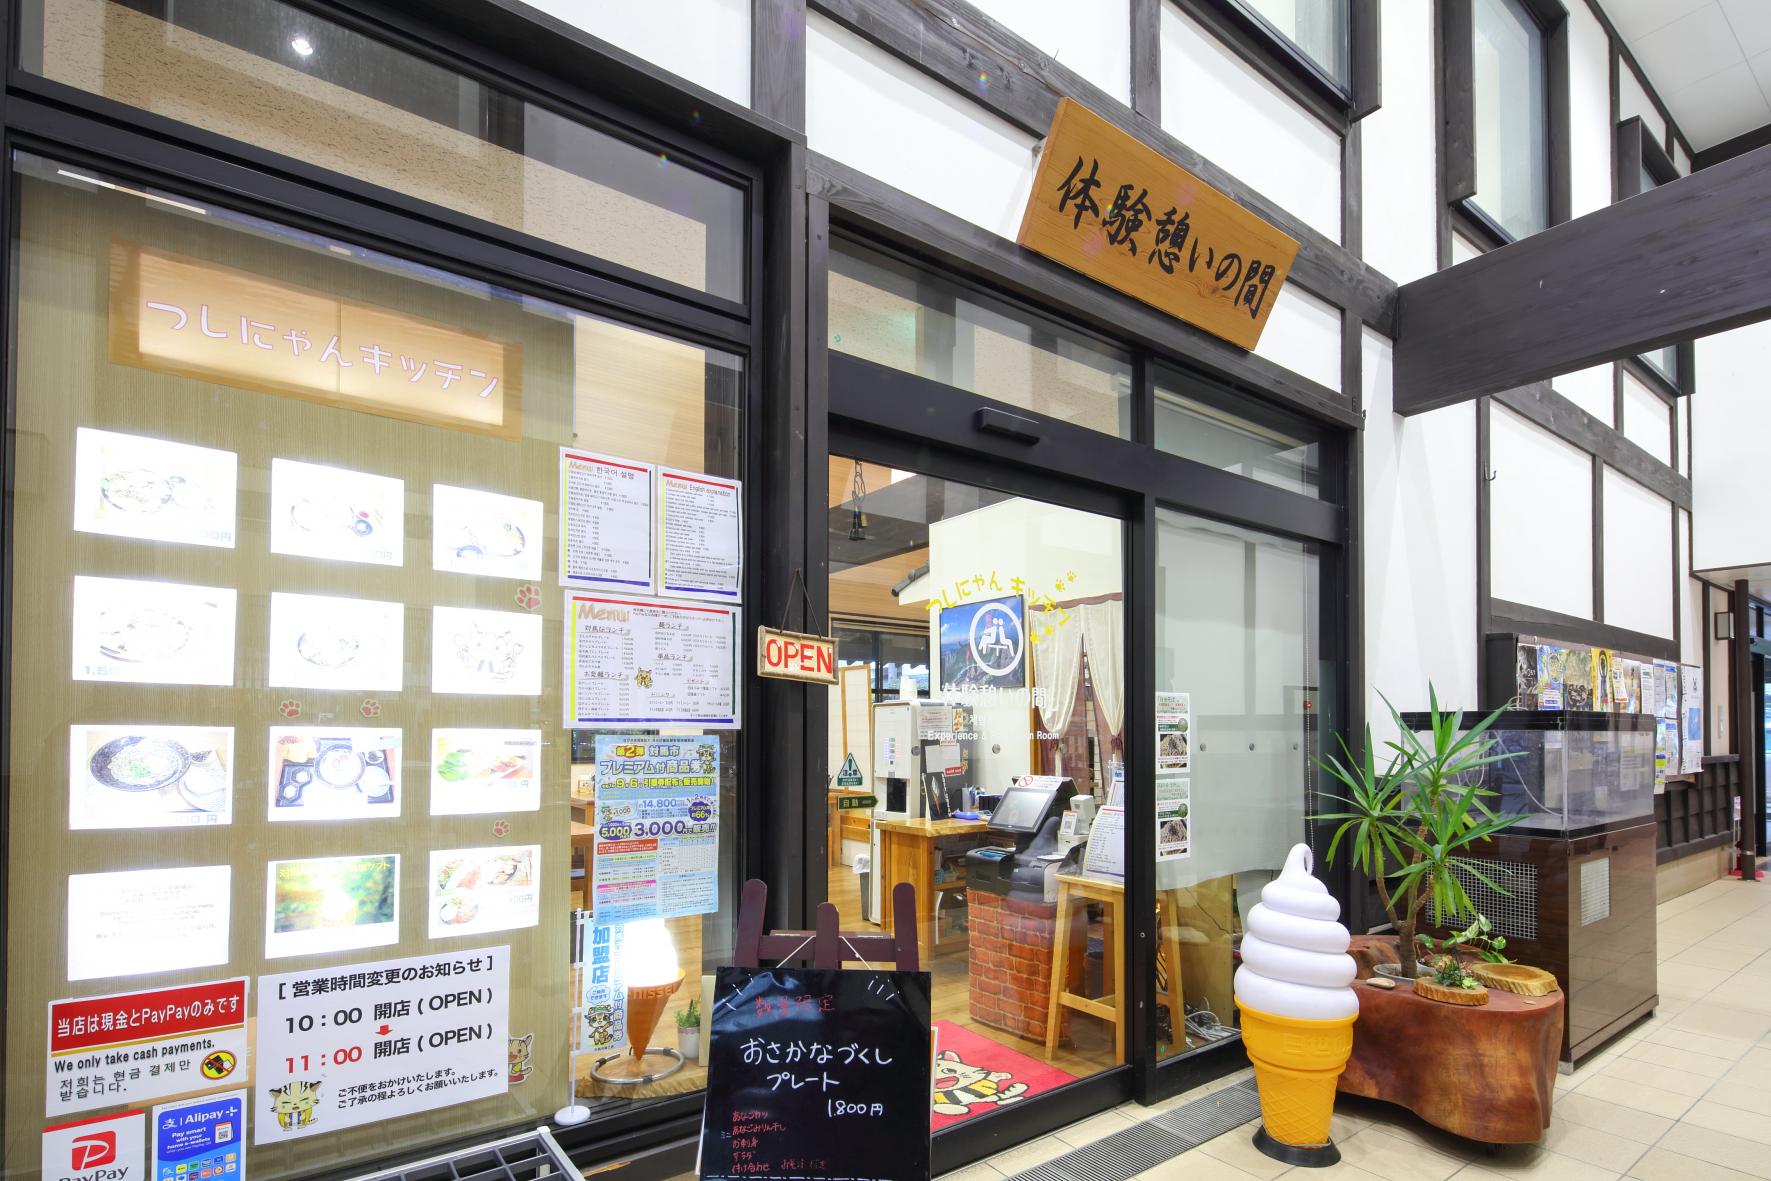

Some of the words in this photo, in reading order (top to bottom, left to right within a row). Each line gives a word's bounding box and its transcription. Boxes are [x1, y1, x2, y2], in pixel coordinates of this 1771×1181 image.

[1057, 155, 1276, 319] 体験憩いの間
[145, 301, 499, 398] つしにゃんキッチン
[765, 639, 833, 674] OPEN
[1037, 731, 1060, 740] Room
[600, 759, 704, 775] プレミアム付商品券
[591, 926, 610, 985] 加盟店
[57, 994, 240, 1038] 当店は現金とPayPayのみです
[285, 1007, 363, 1034] 10:00
[373, 1000, 411, 1022] 開店
[54, 1059, 74, 1074] We
[77, 1055, 101, 1070] only
[105, 1051, 129, 1066] take
[133, 1048, 158, 1062] cash
[162, 1037, 216, 1057] payments.
[285, 1046, 363, 1074] 11:00
[373, 1037, 411, 1060] 開店
[740, 1037, 893, 1065] おさかなづくし
[59, 1081, 128, 1102] 받습니다.
[338, 1067, 456, 1098] ご不便をおかけいたします。
[766, 1071, 841, 1092] プレート
